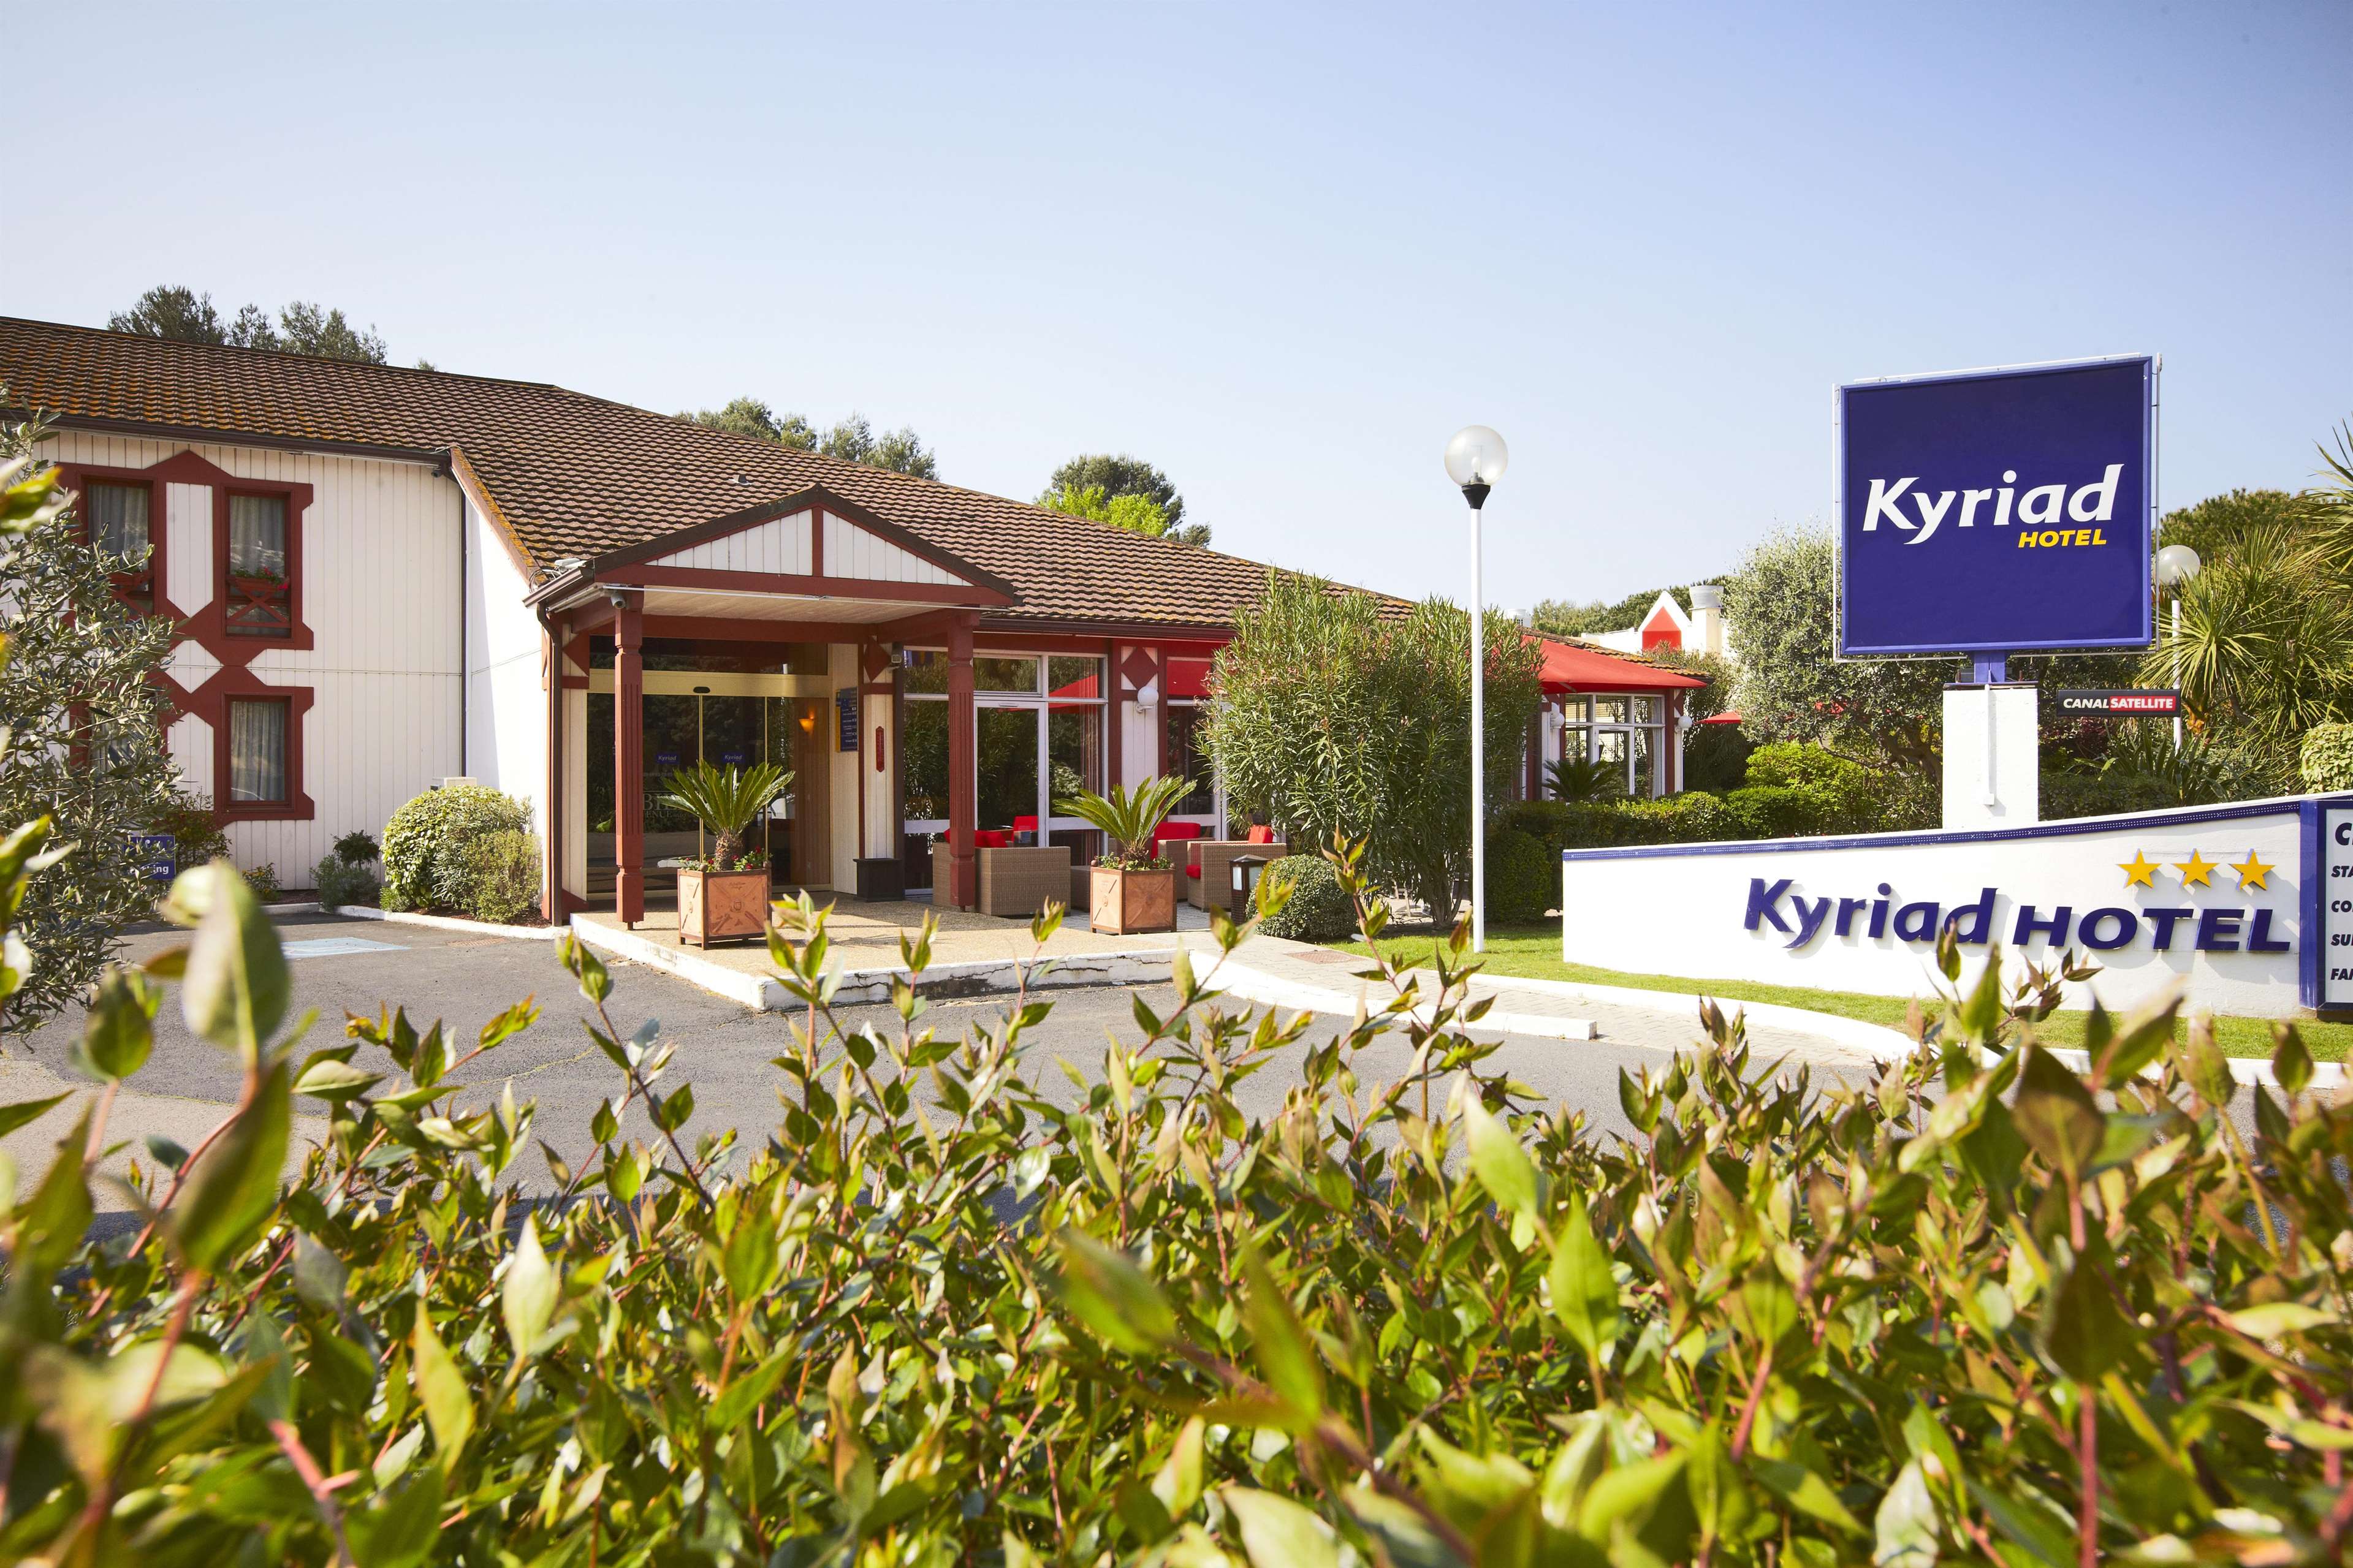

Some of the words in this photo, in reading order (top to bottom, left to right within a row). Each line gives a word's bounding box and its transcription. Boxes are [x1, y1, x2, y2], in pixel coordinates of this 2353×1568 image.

[1863, 463, 2125, 545] Kyriad
[2018, 528, 2107, 548] HOTEL
[2335, 822, 2353, 846] C
[1744, 878, 1999, 948] Kyriad
[2012, 906, 2290, 951] HOTEL
[2331, 900, 2353, 913] CO
[2331, 934, 2353, 946] SU
